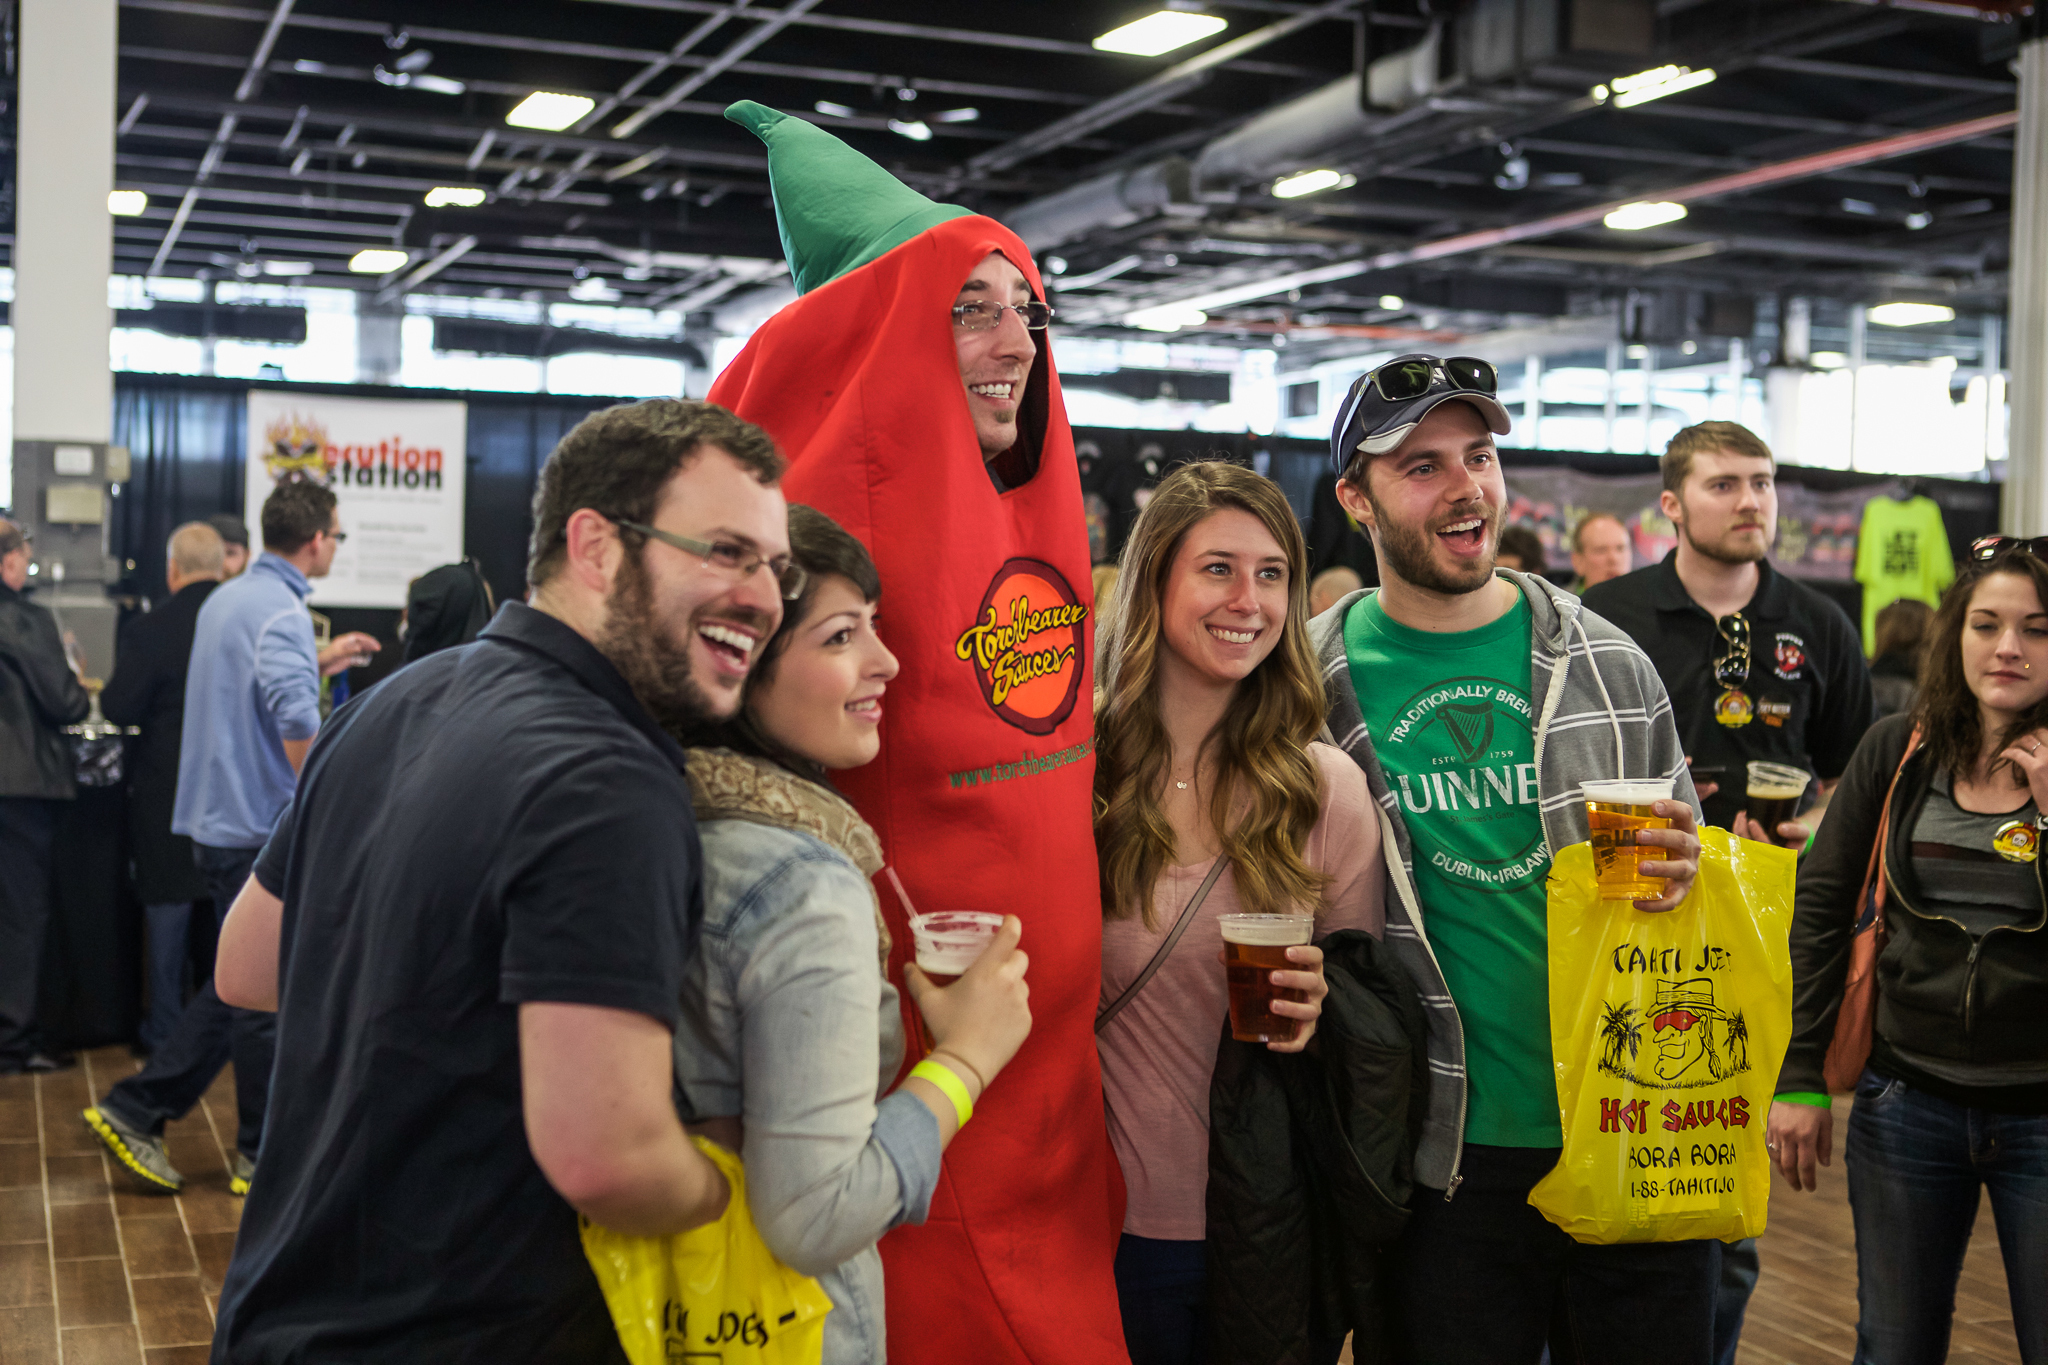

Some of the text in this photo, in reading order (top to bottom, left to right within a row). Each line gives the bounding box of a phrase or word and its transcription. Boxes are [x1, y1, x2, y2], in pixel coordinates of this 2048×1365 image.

[956, 595, 1090, 671] Torchbearer
[992, 646, 1076, 706] Sauces
[1388, 685, 1494, 744] TRADITIONALLY
[1490, 750, 1514, 759] 1759
[1495, 811, 1515, 820] Gate
[1599, 1097, 1651, 1134] HOT
[1629, 1142, 1737, 1169] BORA BORA
[1631, 1176, 1735, 1198] 1-88-TAHITIJO
